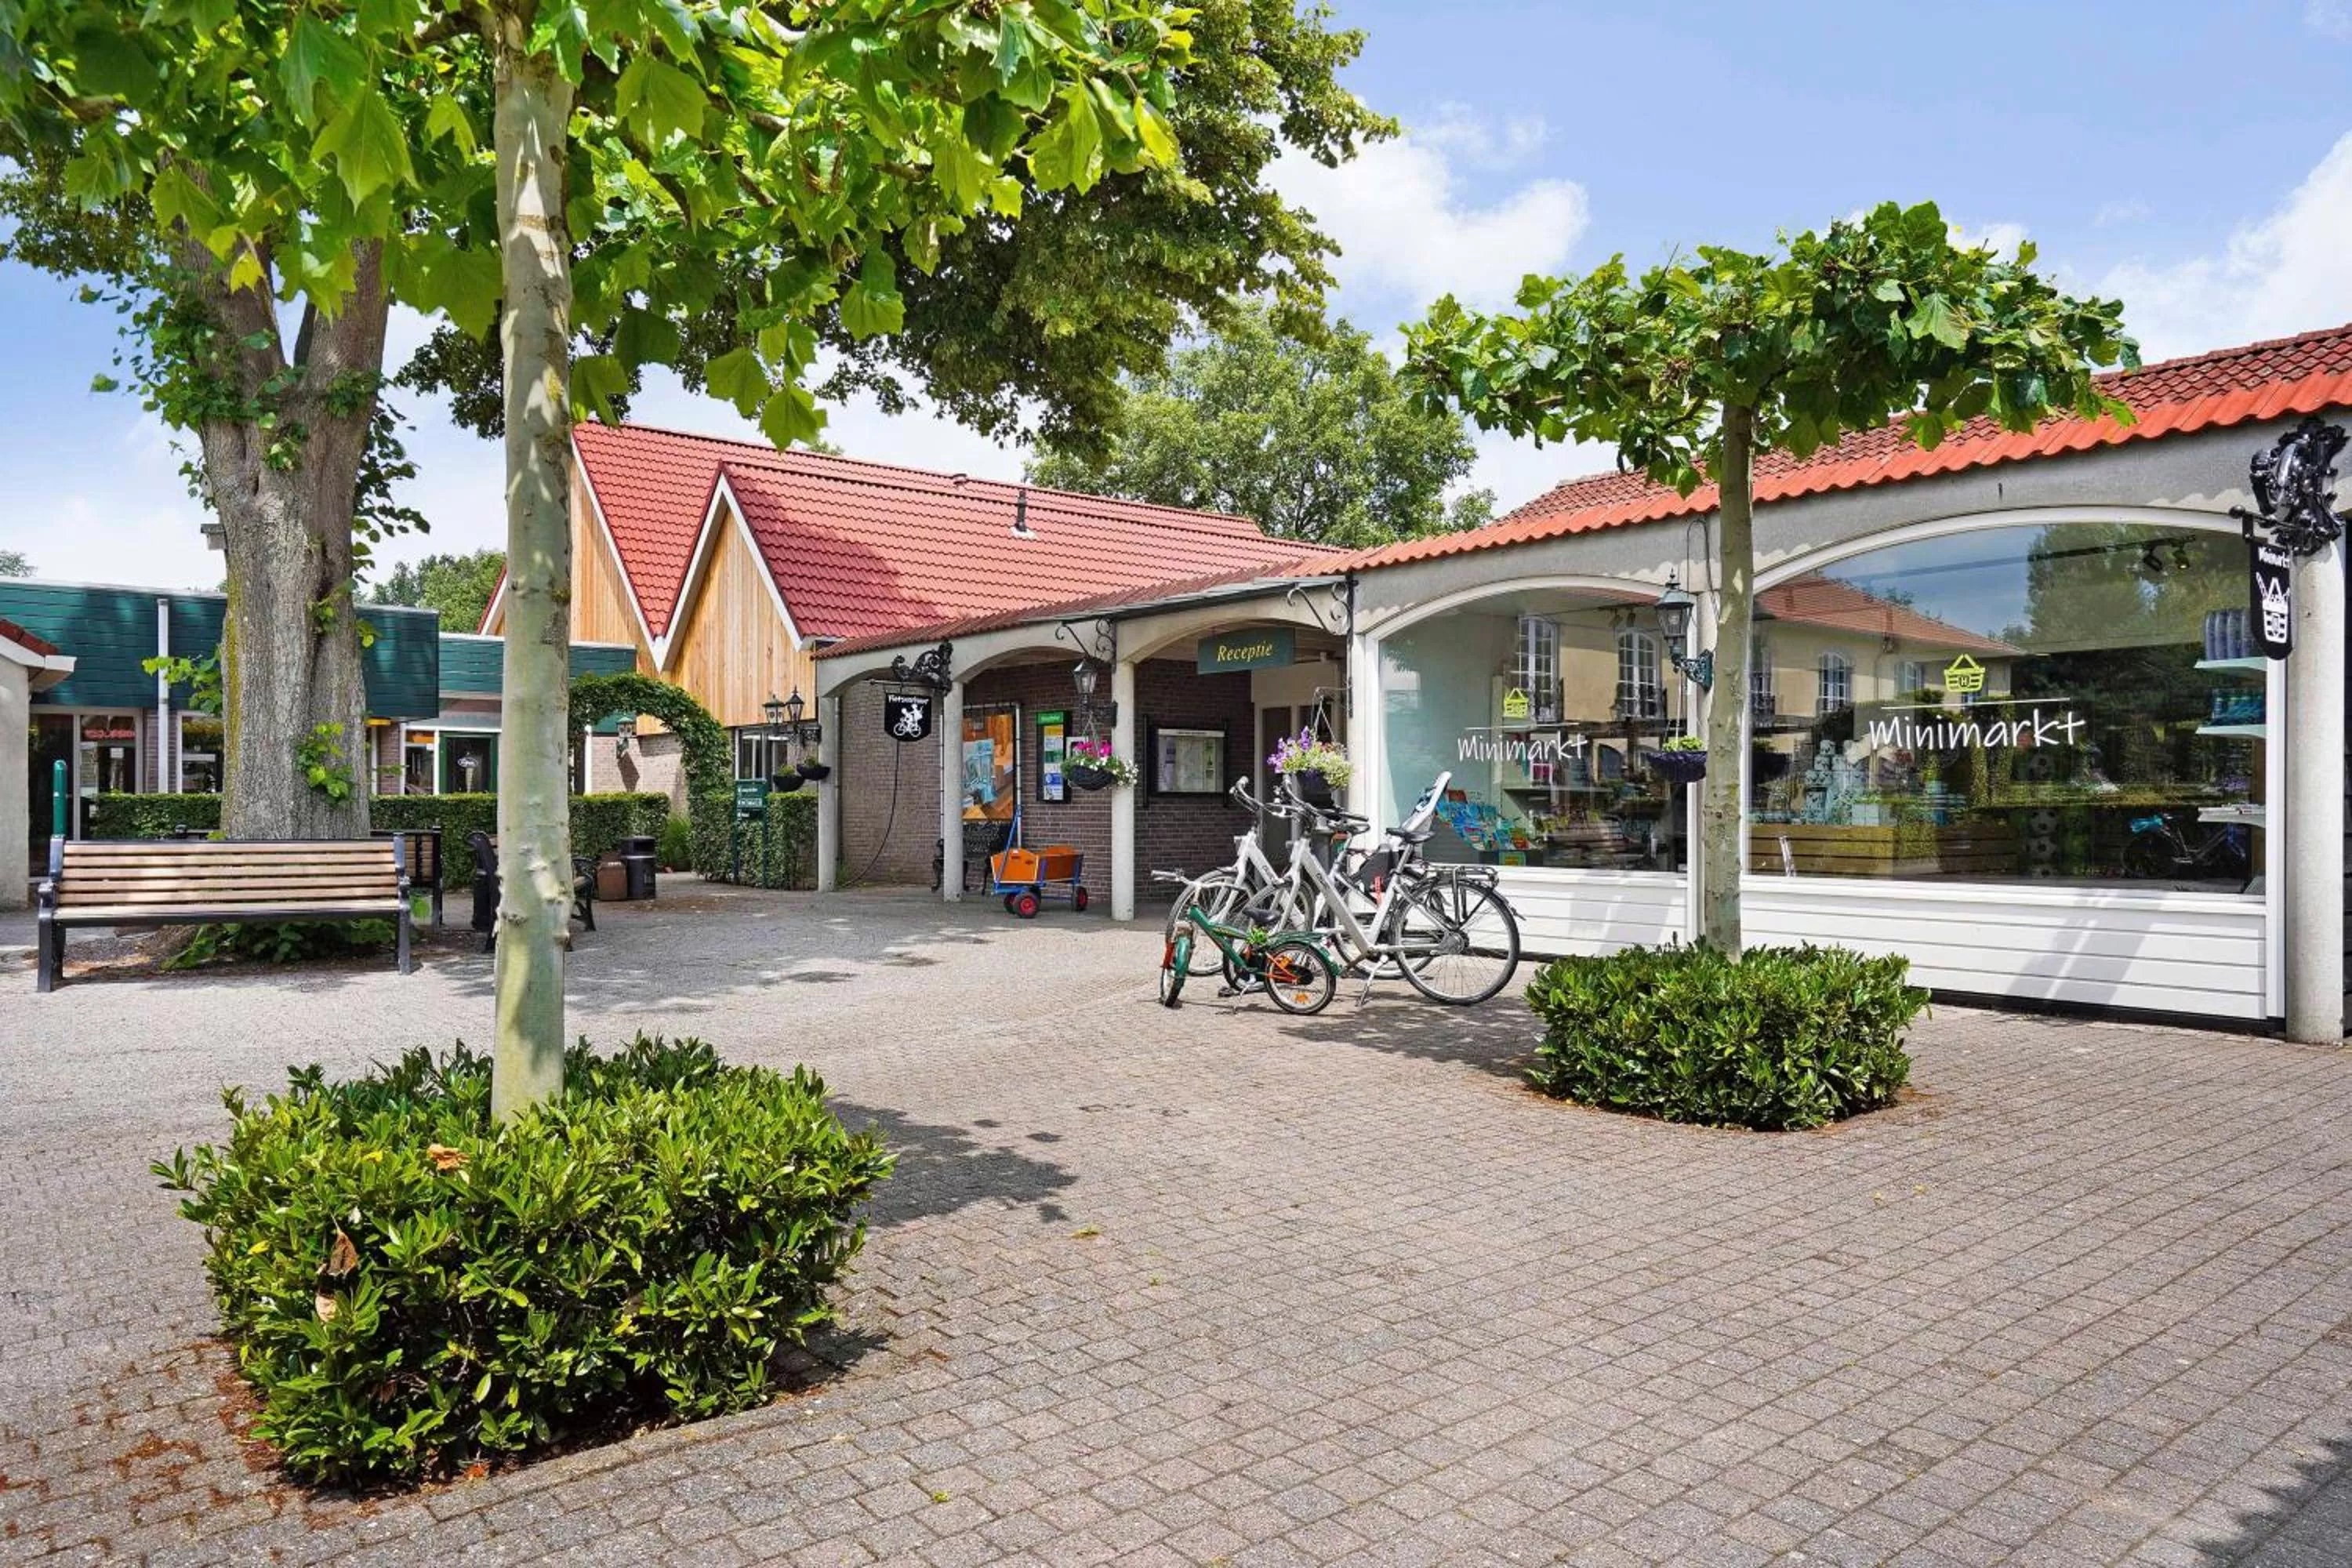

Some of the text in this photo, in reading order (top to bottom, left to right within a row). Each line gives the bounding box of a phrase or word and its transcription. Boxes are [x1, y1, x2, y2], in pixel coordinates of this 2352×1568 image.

[1217, 641, 1273, 662] Receptie
[1869, 708, 2086, 750] Minimarkt
[1457, 730, 1590, 763] Minimarkt
